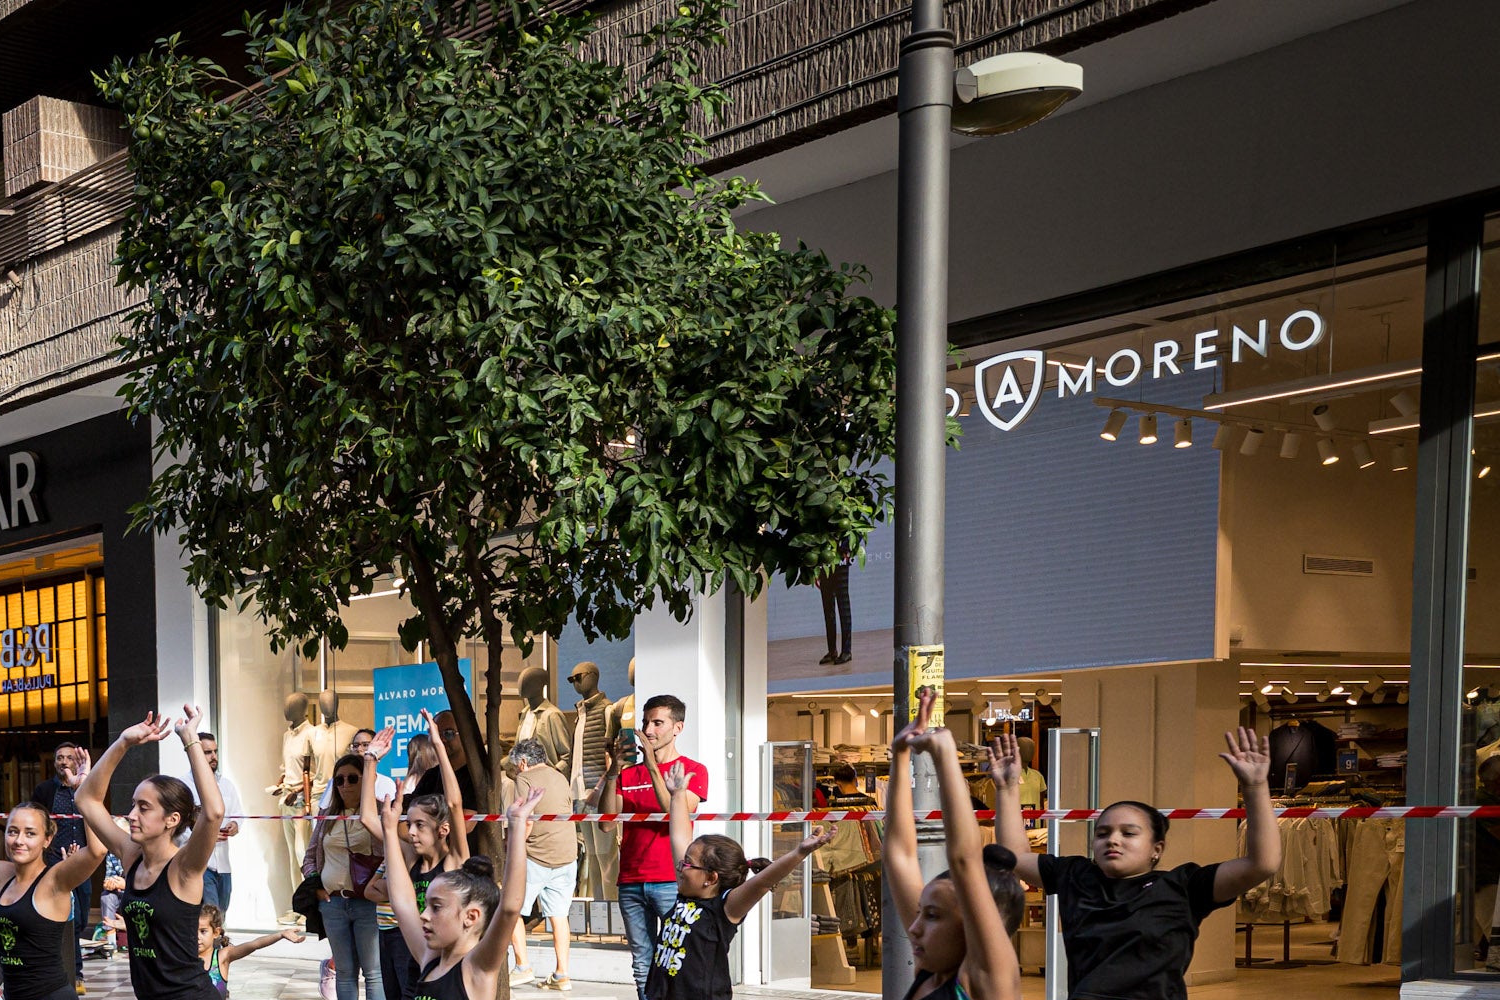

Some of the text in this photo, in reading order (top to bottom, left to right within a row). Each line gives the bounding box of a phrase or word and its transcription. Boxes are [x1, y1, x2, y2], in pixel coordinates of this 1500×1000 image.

[1058, 309, 1327, 398] MORENO
[379, 686, 445, 701] ALVARO MOR
[385, 712, 440, 734] REMA
[662, 921, 691, 947] GOT
[655, 943, 687, 971] THIS
